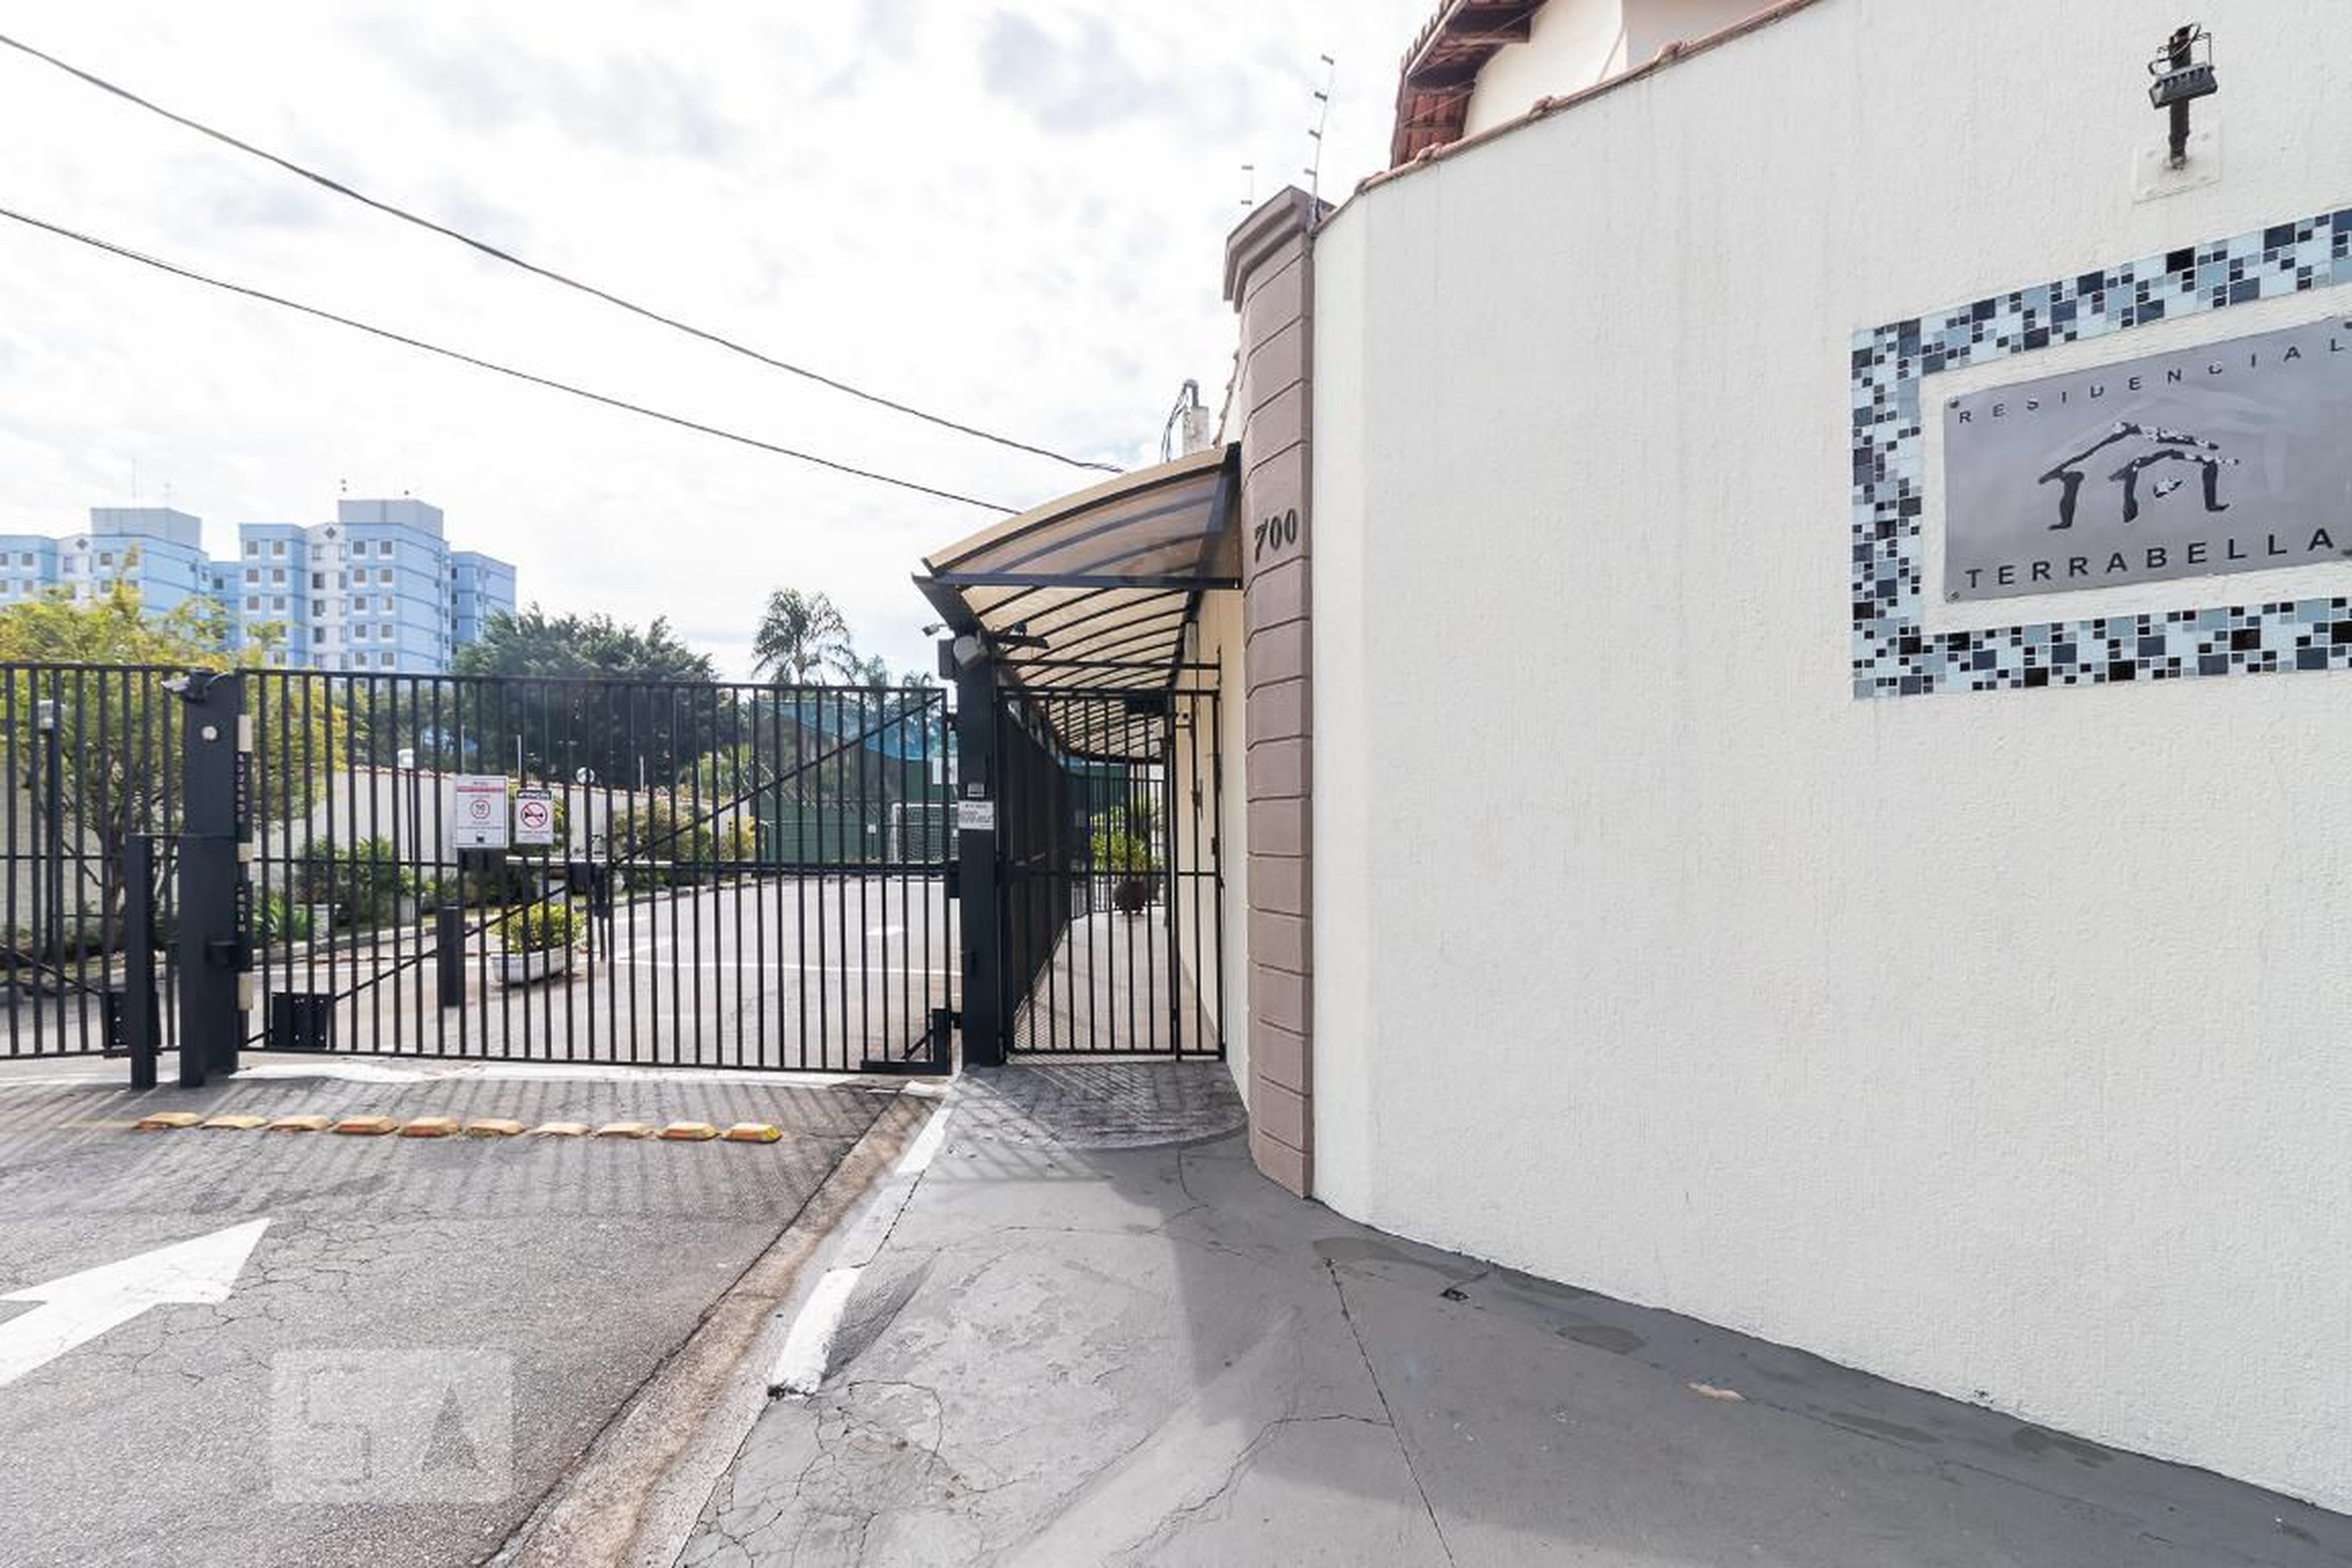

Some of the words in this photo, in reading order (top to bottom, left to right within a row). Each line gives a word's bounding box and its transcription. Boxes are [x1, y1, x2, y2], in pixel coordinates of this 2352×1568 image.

[1959, 338, 2345, 423] RESIDENCIAL
[1255, 508, 1297, 563] 700
[1965, 527, 2335, 589] TERRABELLA
